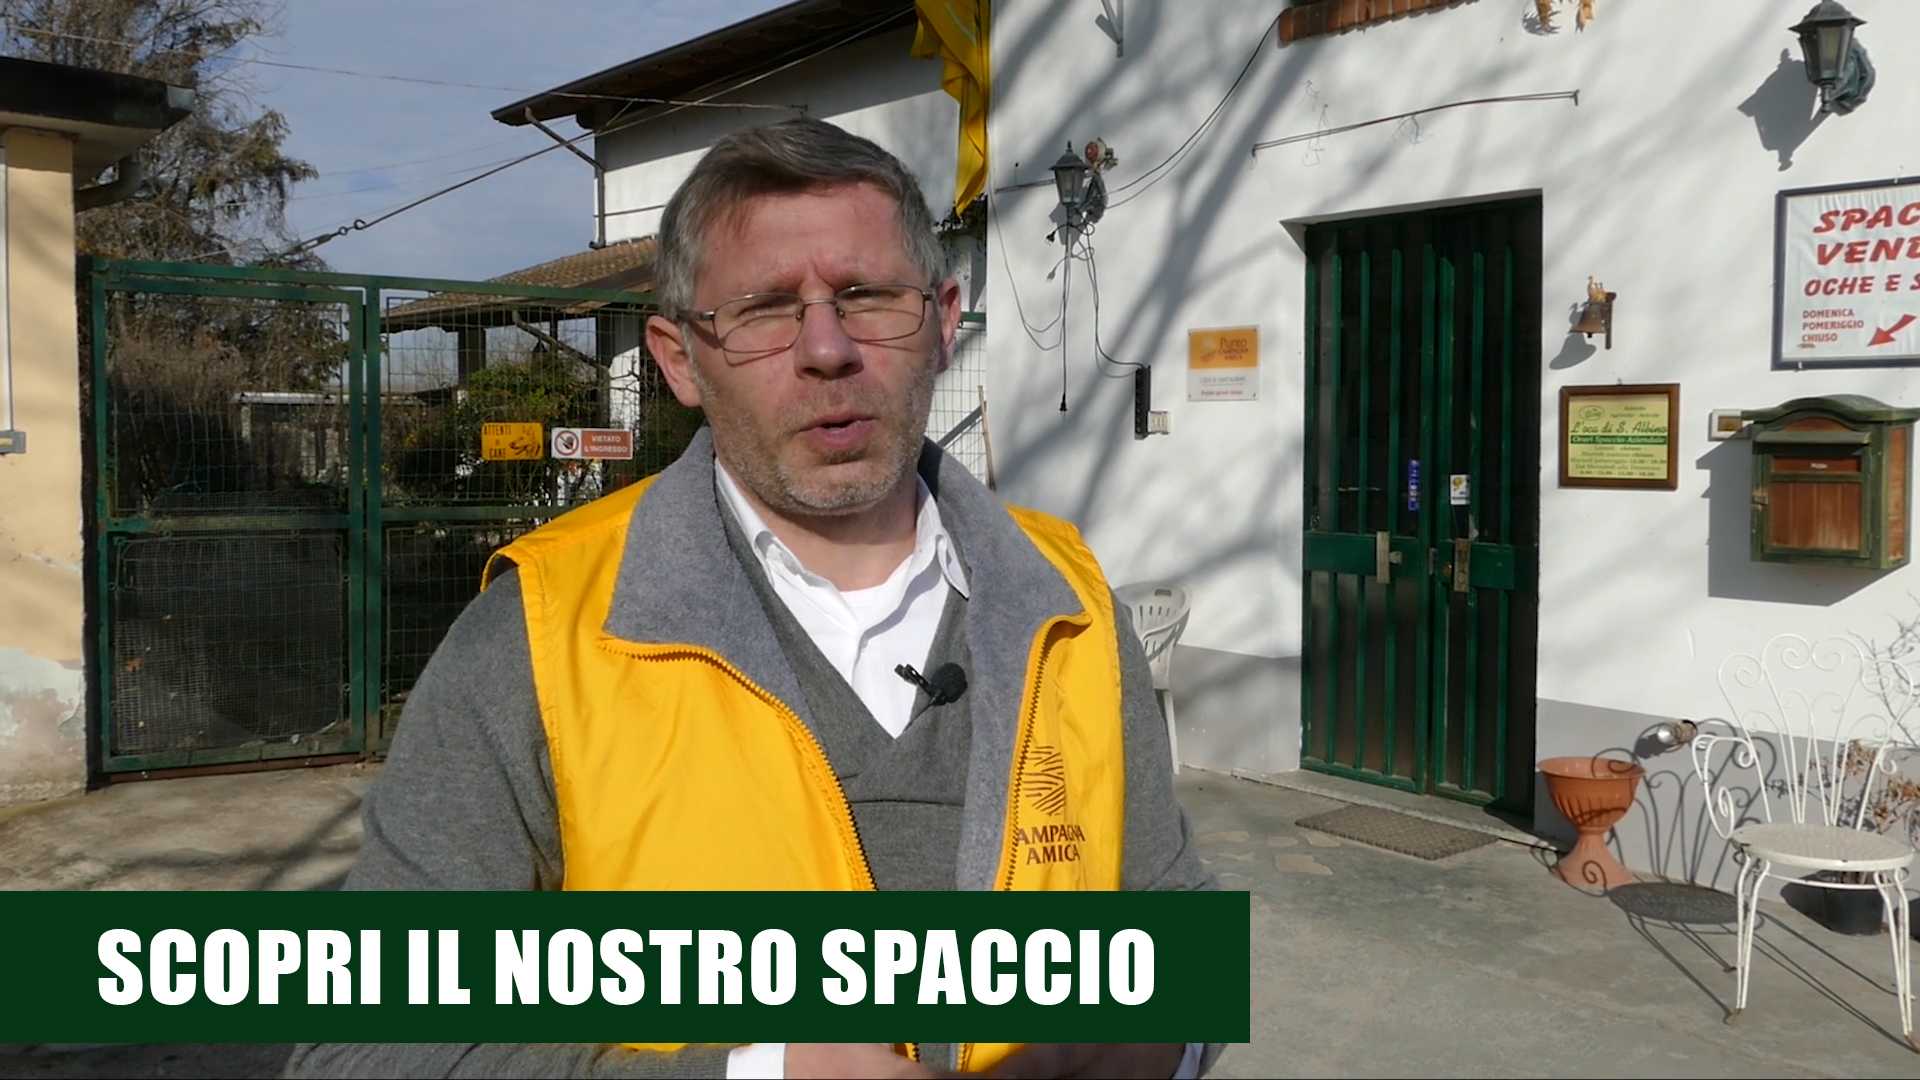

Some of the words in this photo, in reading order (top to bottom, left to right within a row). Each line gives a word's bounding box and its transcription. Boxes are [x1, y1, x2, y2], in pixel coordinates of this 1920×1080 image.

[1804, 276, 1874, 296] OCHE
[1885, 274, 1901, 292] E
[1802, 309, 1854, 319] DOMENICA
[1802, 320, 1864, 330] POMERIGGIO
[1802, 333, 1838, 342] CHIUSO
[485, 424, 511, 436] ATTENTI
[1027, 845, 1081, 865] AMICA
